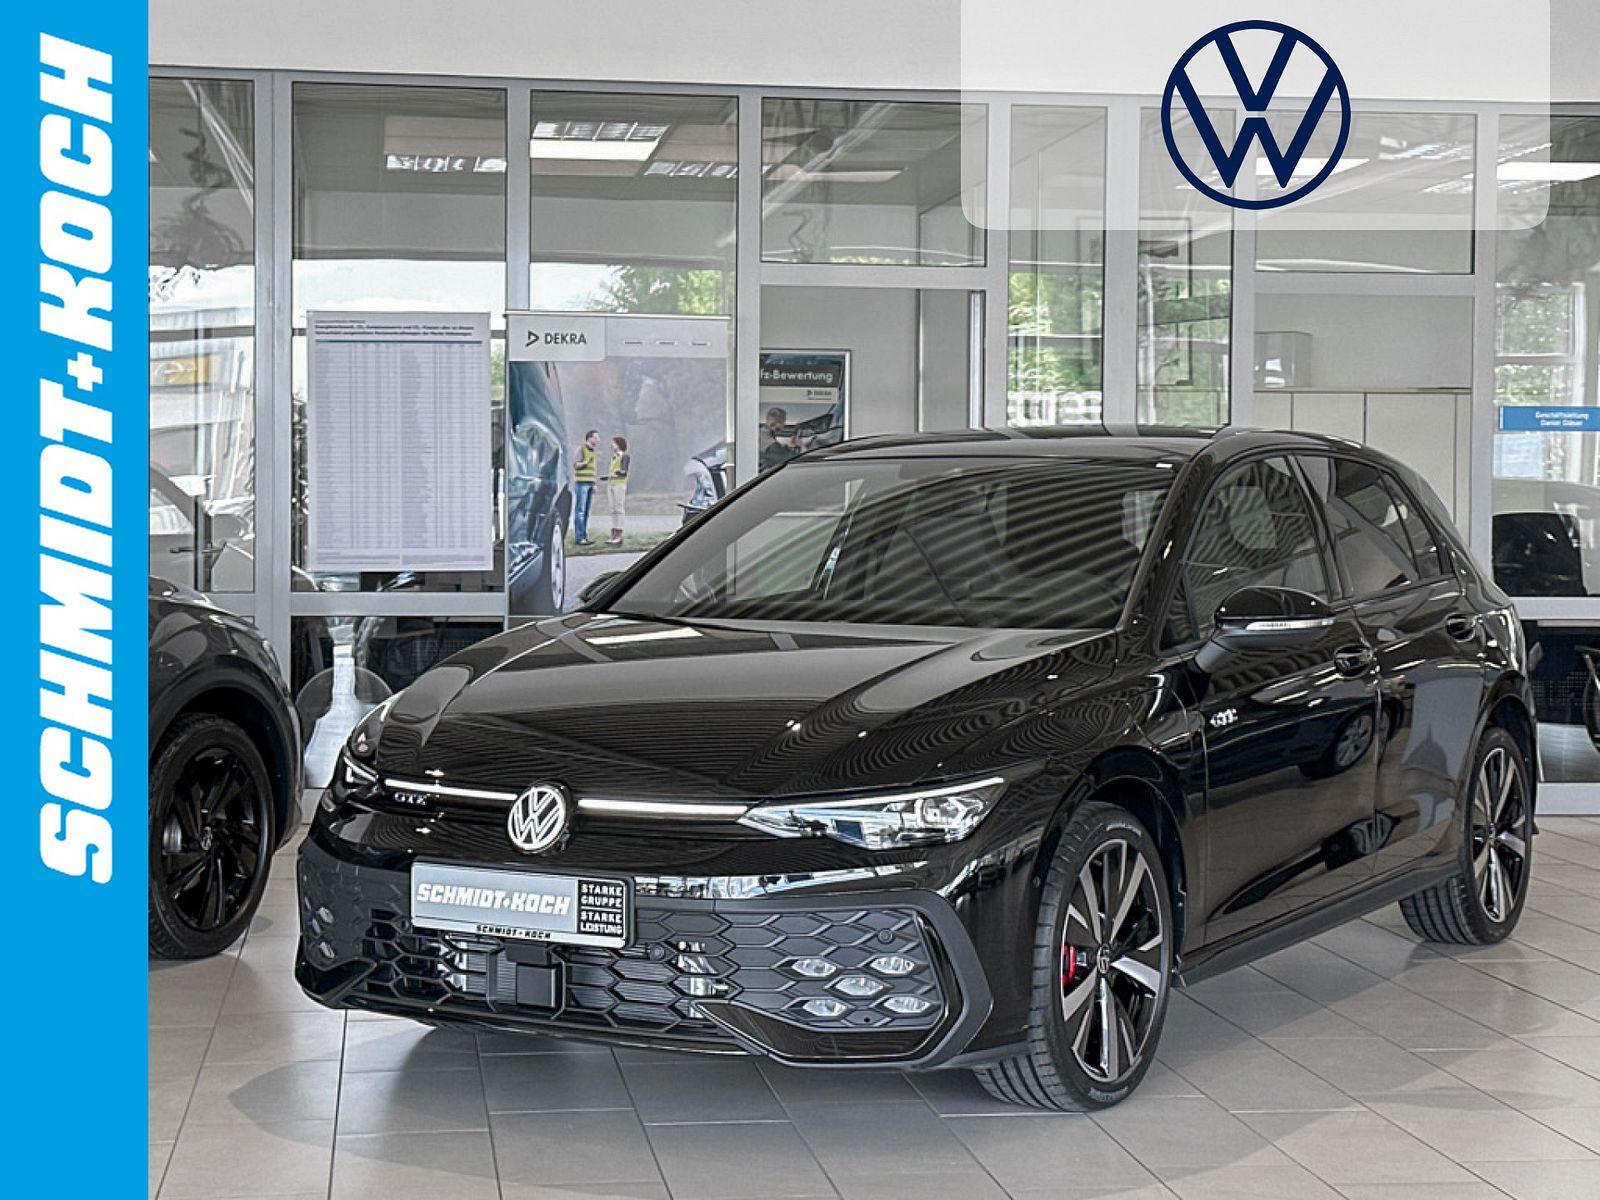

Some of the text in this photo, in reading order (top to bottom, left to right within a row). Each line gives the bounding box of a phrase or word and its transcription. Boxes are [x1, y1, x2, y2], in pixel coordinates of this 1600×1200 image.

[544, 331, 588, 345] DEKRA
[580, 883, 623, 896] STARKE
[416, 882, 572, 916] SCHMIDT+KOCH
[580, 895, 623, 908] GRUPPE
[580, 910, 623, 924] STARKE
[580, 921, 623, 935] LEISTUNG
